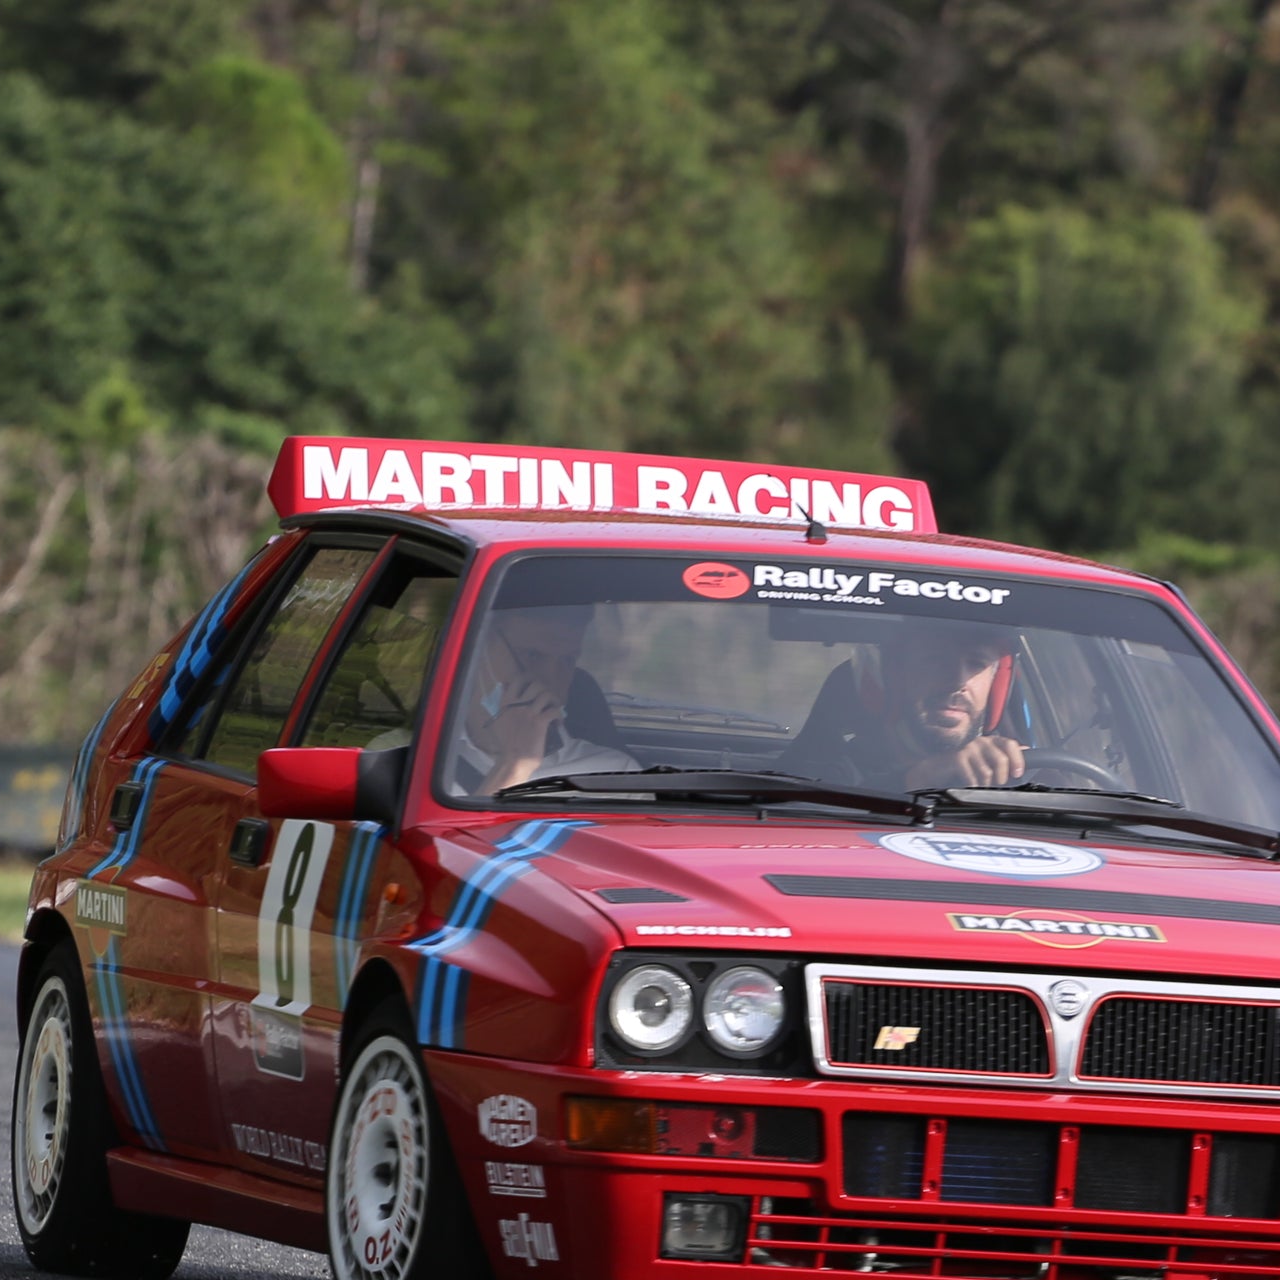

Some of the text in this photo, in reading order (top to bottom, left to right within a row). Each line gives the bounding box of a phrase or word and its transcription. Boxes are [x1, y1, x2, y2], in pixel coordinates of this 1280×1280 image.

[303, 446, 914, 531] MARTINI RACING
[753, 565, 1010, 605] Rally Factor
[757, 590, 885, 605] DRIVING SCHOOL
[941, 843, 1053, 858] LANCIA
[77, 888, 124, 925] MARTINI
[275, 822, 315, 1007] 8
[636, 925, 792, 938] MICHELIN
[960, 916, 1150, 939] MARTINI
